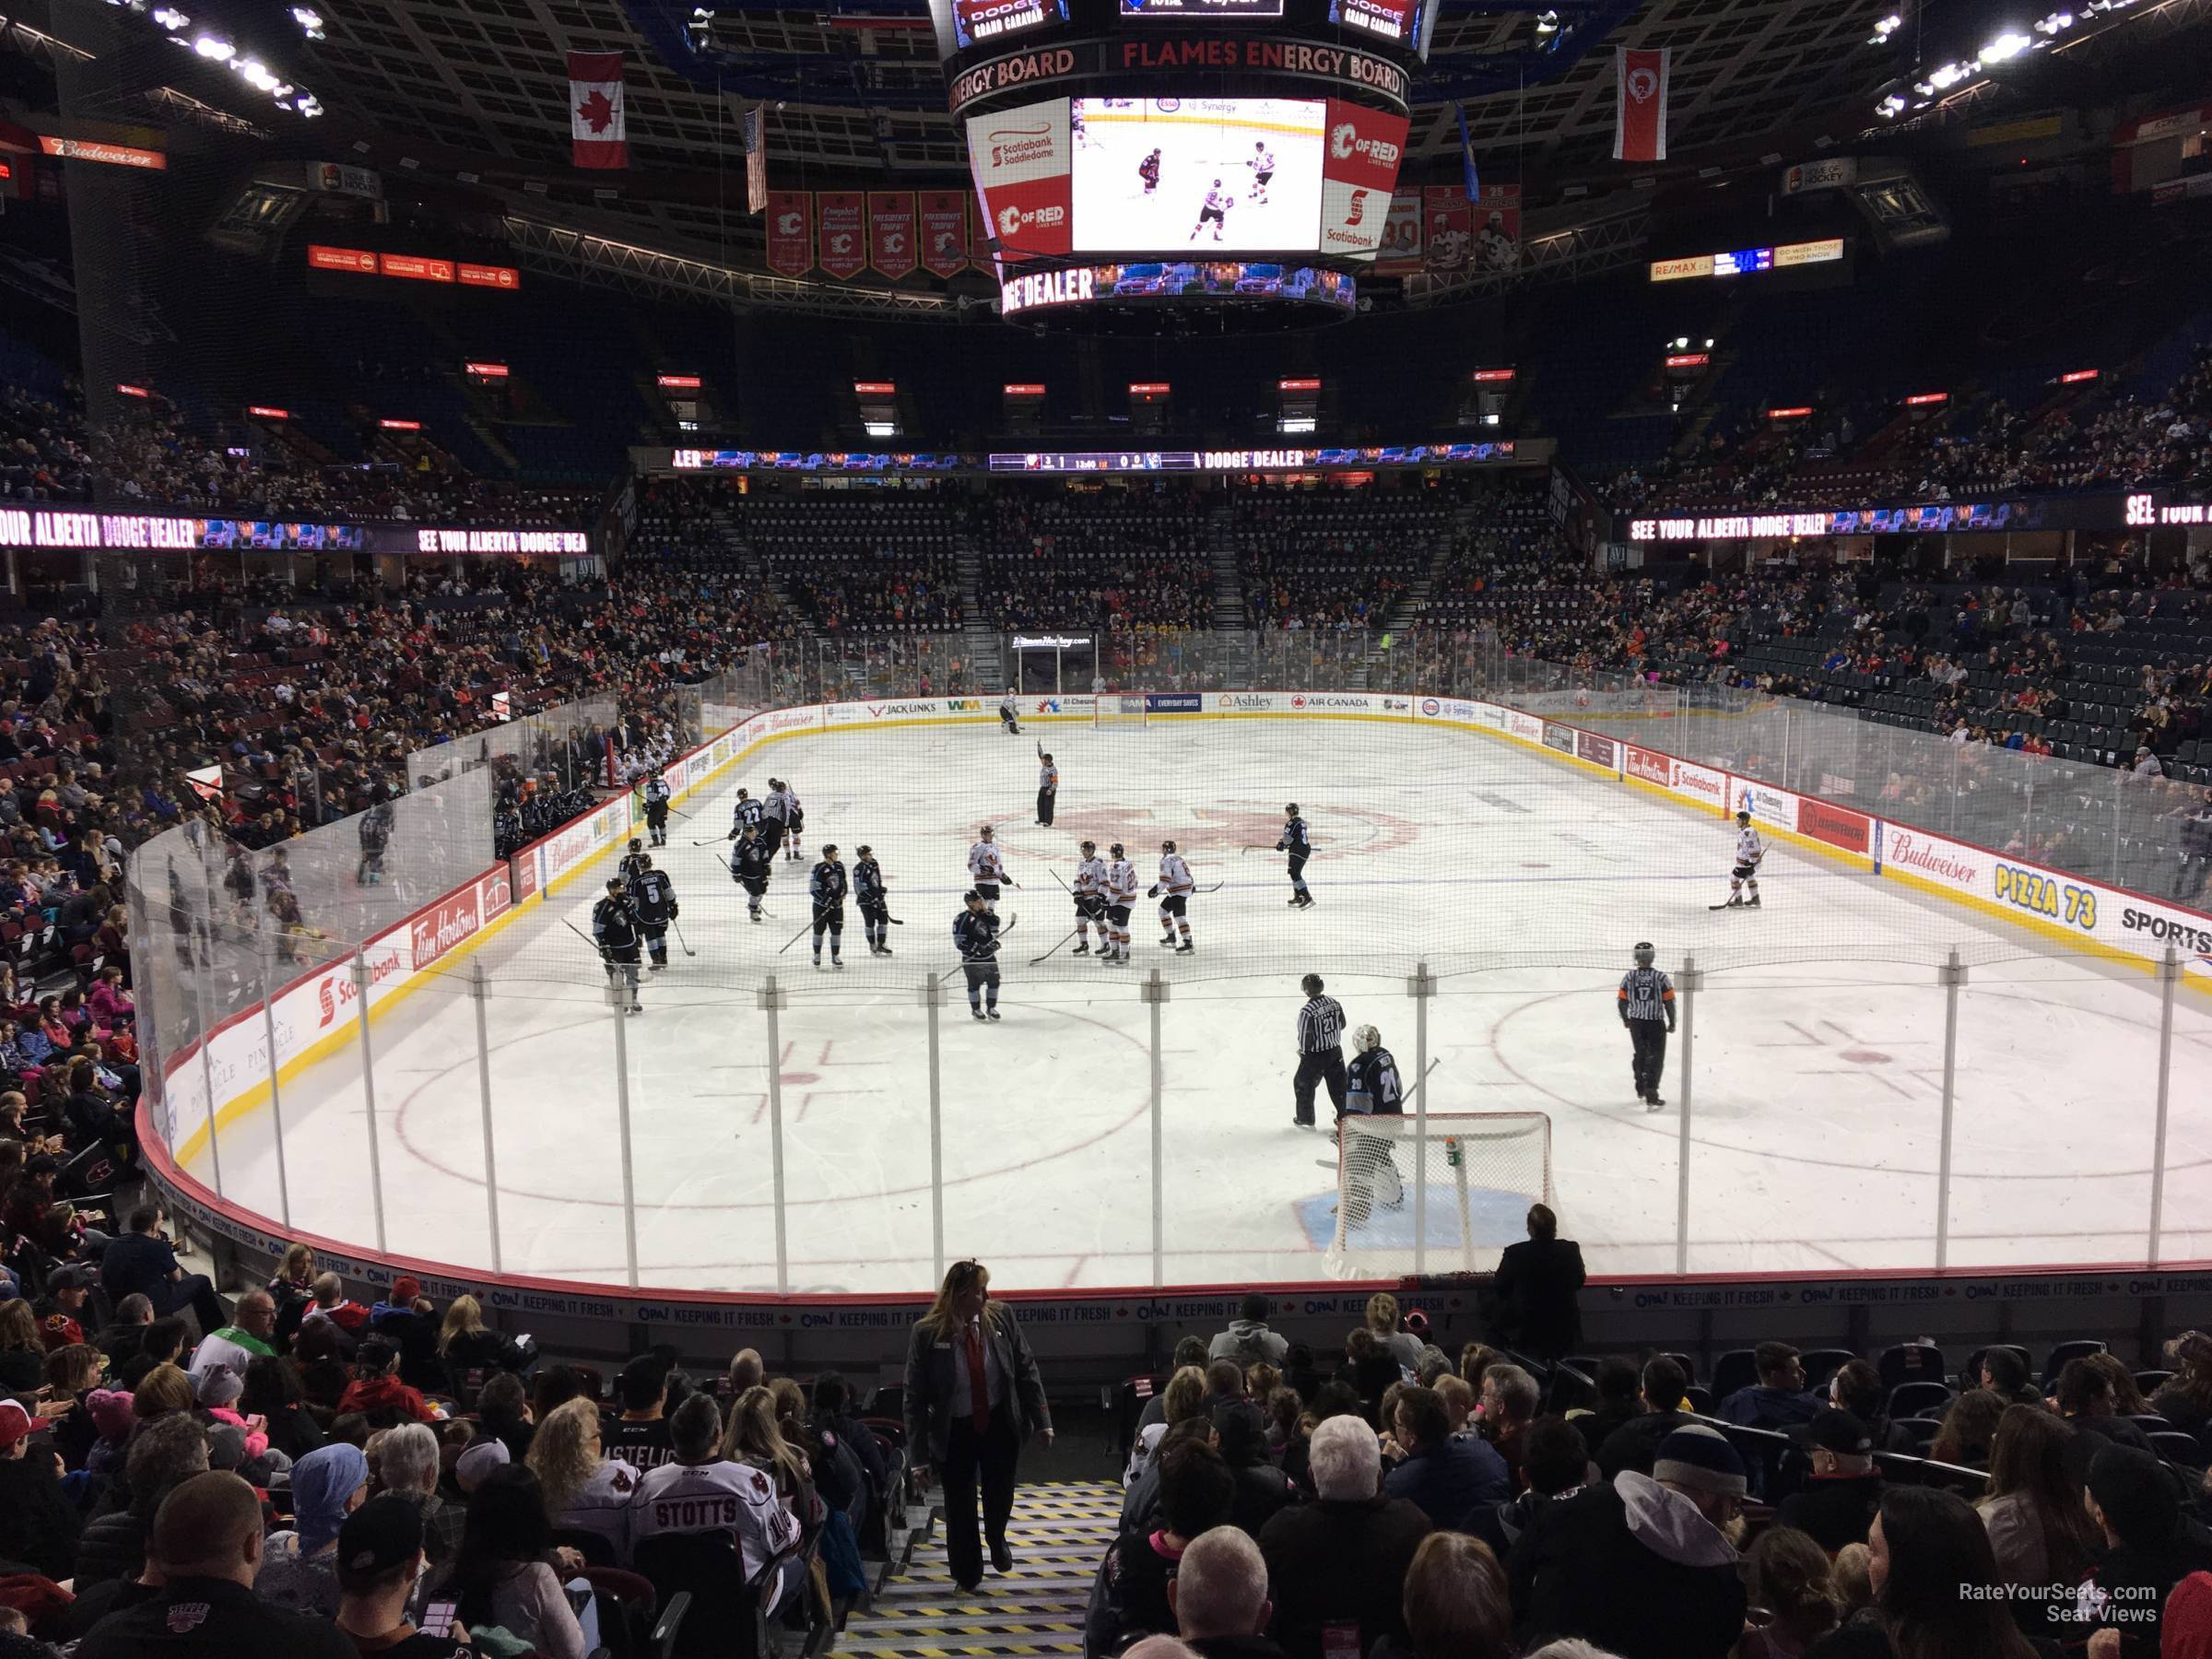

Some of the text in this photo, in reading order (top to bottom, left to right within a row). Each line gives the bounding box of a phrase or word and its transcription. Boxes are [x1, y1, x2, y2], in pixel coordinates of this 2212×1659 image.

[974, 8, 1043, 38] GRAND CARAVAN
[1345, 7, 1401, 39] GRAND CARAVAN
[998, 49, 1075, 86] BOARD
[1124, 41, 1400, 93] FLAMES ENERGY BOARD
[1202, 101, 1237, 113] Synergy
[51, 138, 152, 167] Budweiser
[1004, 136, 1053, 155] Scotiabank
[1356, 141, 1371, 152] OF
[1370, 138, 1399, 163] RED
[1004, 148, 1054, 166] Saddledome
[1805, 172, 1843, 185] HOCKEY
[1828, 165, 1841, 174] OF
[1488, 187, 1504, 196] 25
[1021, 212, 1035, 223] OF
[1035, 206, 1065, 224] RED
[1327, 229, 1373, 248] Scotiabank
[1814, 242, 1840, 253] THOSE
[1806, 252, 1831, 261] KNOW
[1655, 262, 1697, 276] RE/MAX
[1024, 268, 1093, 308] DEALER
[673, 450, 701, 467] LER
[1120, 455, 1127, 467] 0
[1205, 452, 1249, 468] DODGE
[1253, 450, 1304, 467] DEALER
[35, 511, 100, 547] ALBERTA
[102, 515, 148, 547] DODGE
[149, 516, 195, 548] DEALER
[1631, 512, 1826, 540] SEE YOUR ALBERTA DODGE DEALER
[418, 529, 438, 552] SEE
[439, 530, 468, 552] YOUR
[469, 531, 518, 552] ALBERTA
[520, 531, 561, 553] DODGE
[886, 701, 936, 715] JACK LINK'S
[1233, 695, 1273, 709] Ashley
[1309, 699, 1370, 708] AIR CANADA
[770, 713, 814, 731] Budweiser
[1628, 750, 1667, 785] Tim Hortons
[1681, 771, 1721, 795] Scotiabank
[1890, 830, 1976, 883] Budweiser
[647, 884, 659, 904] 5
[1994, 863, 2097, 930] PIZZA 73
[414, 907, 477, 966] Tim Hortons
[2122, 908, 2212, 955] SPORTS
[338, 950, 400, 1006] Scobank
[1324, 1016, 1335, 1032] 21
[325, 1258, 350, 1275] FRESH
[430, 1282, 439, 1294] IT
[1839, 1287, 1887, 1302] KEEPING
[1889, 1287, 1900, 1300] IT
[1902, 1286, 1939, 1300] FRESH
[2003, 1283, 2050, 1298] KEEPING
[2053, 1282, 2065, 1297] IT
[2067, 1281, 2102, 1296] FRESH
[524, 1295, 566, 1312] KEEPING
[568, 1300, 578, 1313] IT
[581, 1301, 614, 1317] FRESH
[1409, 1298, 1444, 1311] FRESH
[1674, 1292, 1722, 1306] KEEPING
[1724, 1291, 1736, 1305] IT
[1738, 1289, 1774, 1304] FRESH
[674, 1309, 722, 1324] KEEPING
[724, 1310, 735, 1324] IT
[738, 1311, 773, 1324] FRESH
[1016, 1306, 1111, 1322] EEPING IT FRESH
[1176, 1302, 1223, 1317] KEEPING
[1227, 1301, 1237, 1314] IT
[839, 1312, 888, 1327] KEEPING
[891, 1312, 903, 1324] IT
[603, 1445, 677, 1467] ASTELIC
[655, 1498, 737, 1527] STOTTS
